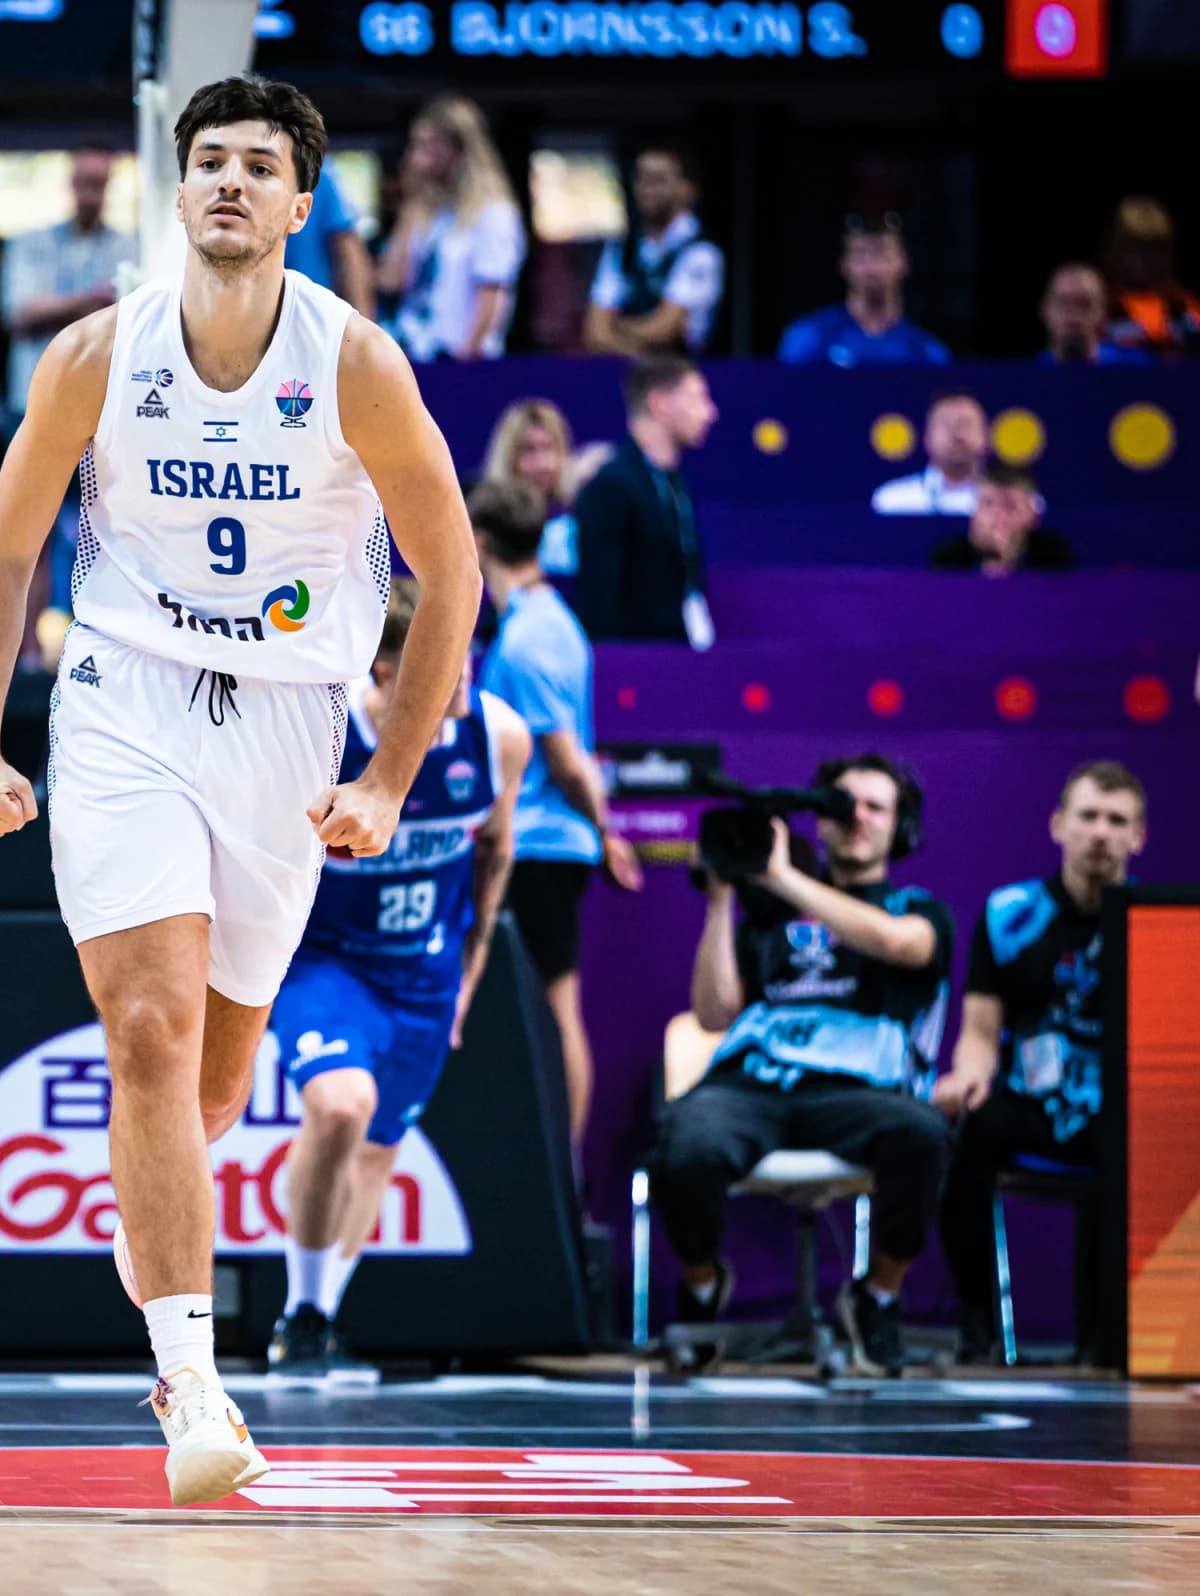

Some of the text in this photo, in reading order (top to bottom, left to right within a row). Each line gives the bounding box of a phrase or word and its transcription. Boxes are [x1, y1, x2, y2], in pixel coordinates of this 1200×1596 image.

[136, 405, 171, 419] PEAK
[147, 459, 300, 501] ISRAEL
[207, 517, 247, 575] 9
[69, 667, 104, 689] PEAK
[377, 879, 438, 933] 29
